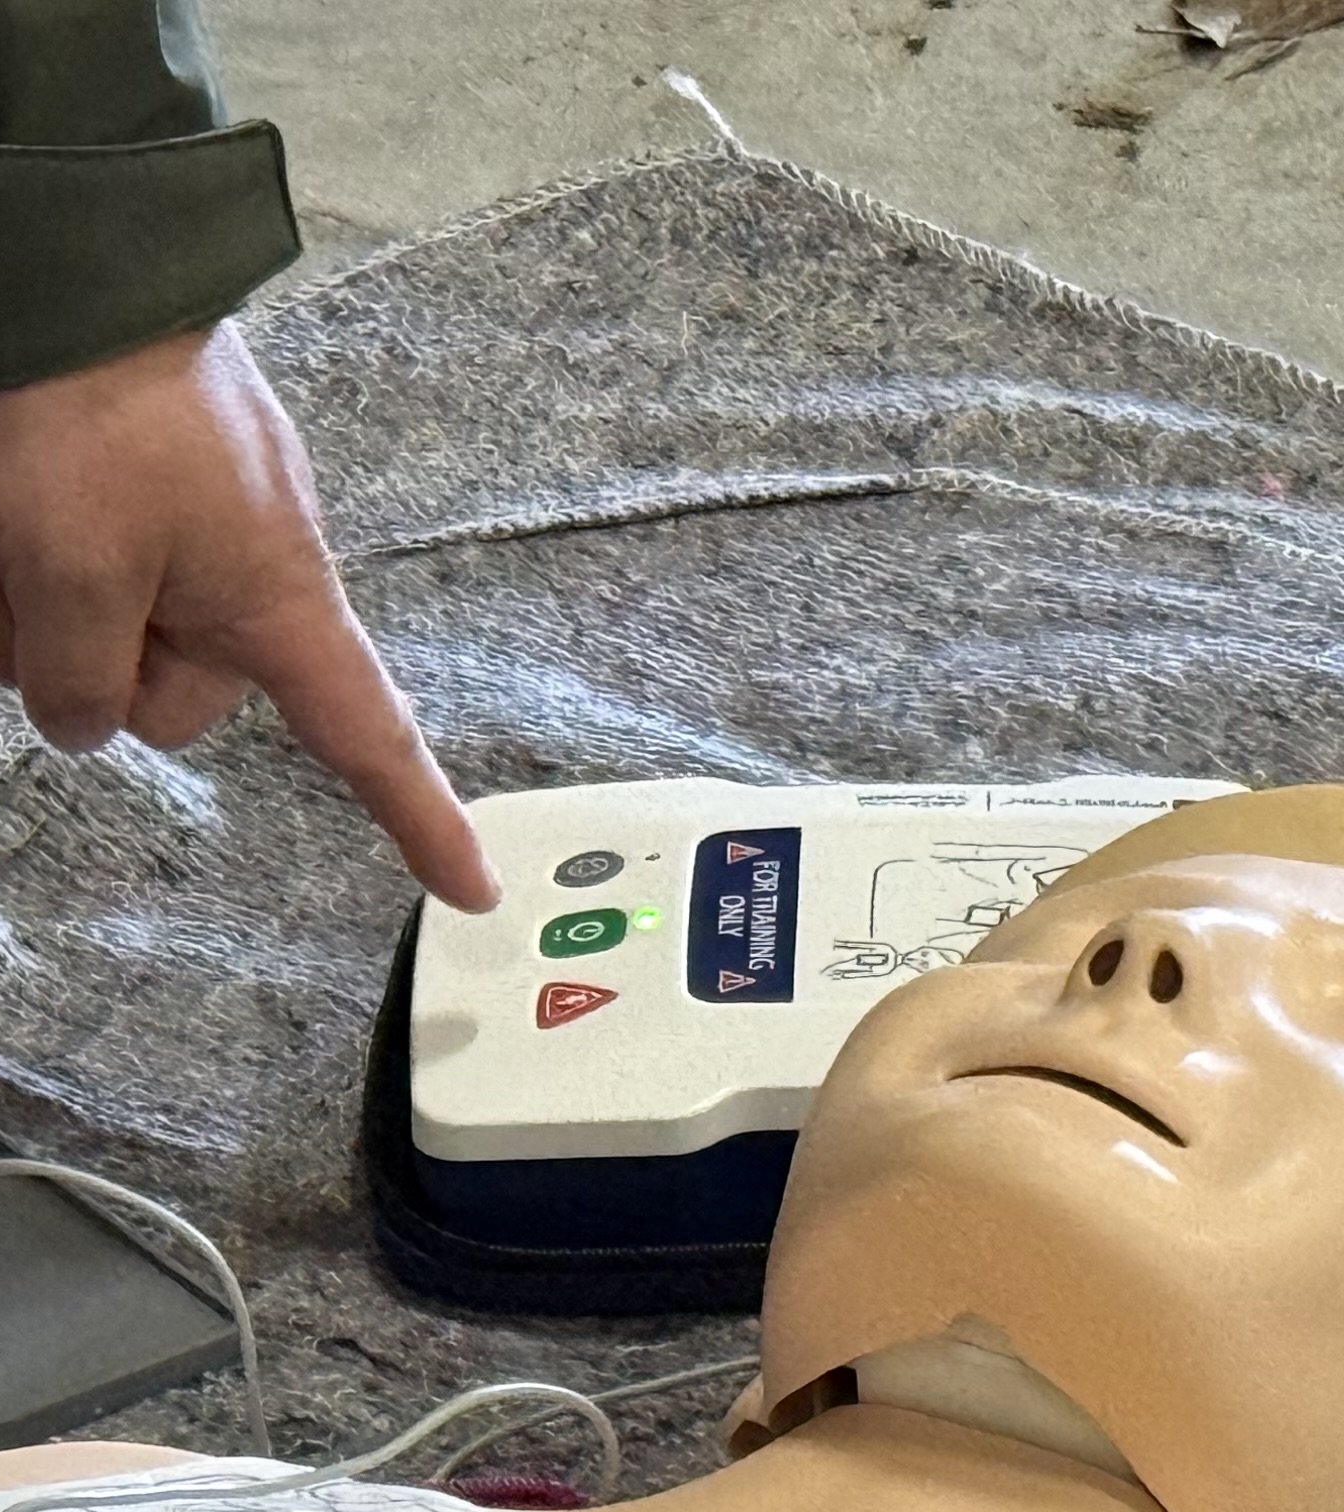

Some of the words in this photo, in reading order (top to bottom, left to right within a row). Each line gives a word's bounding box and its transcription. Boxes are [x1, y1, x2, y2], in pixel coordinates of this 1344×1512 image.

[752, 860, 781, 892] FOR
[718, 895, 746, 937] ONLY
[749, 895, 778, 970] TRAINING
